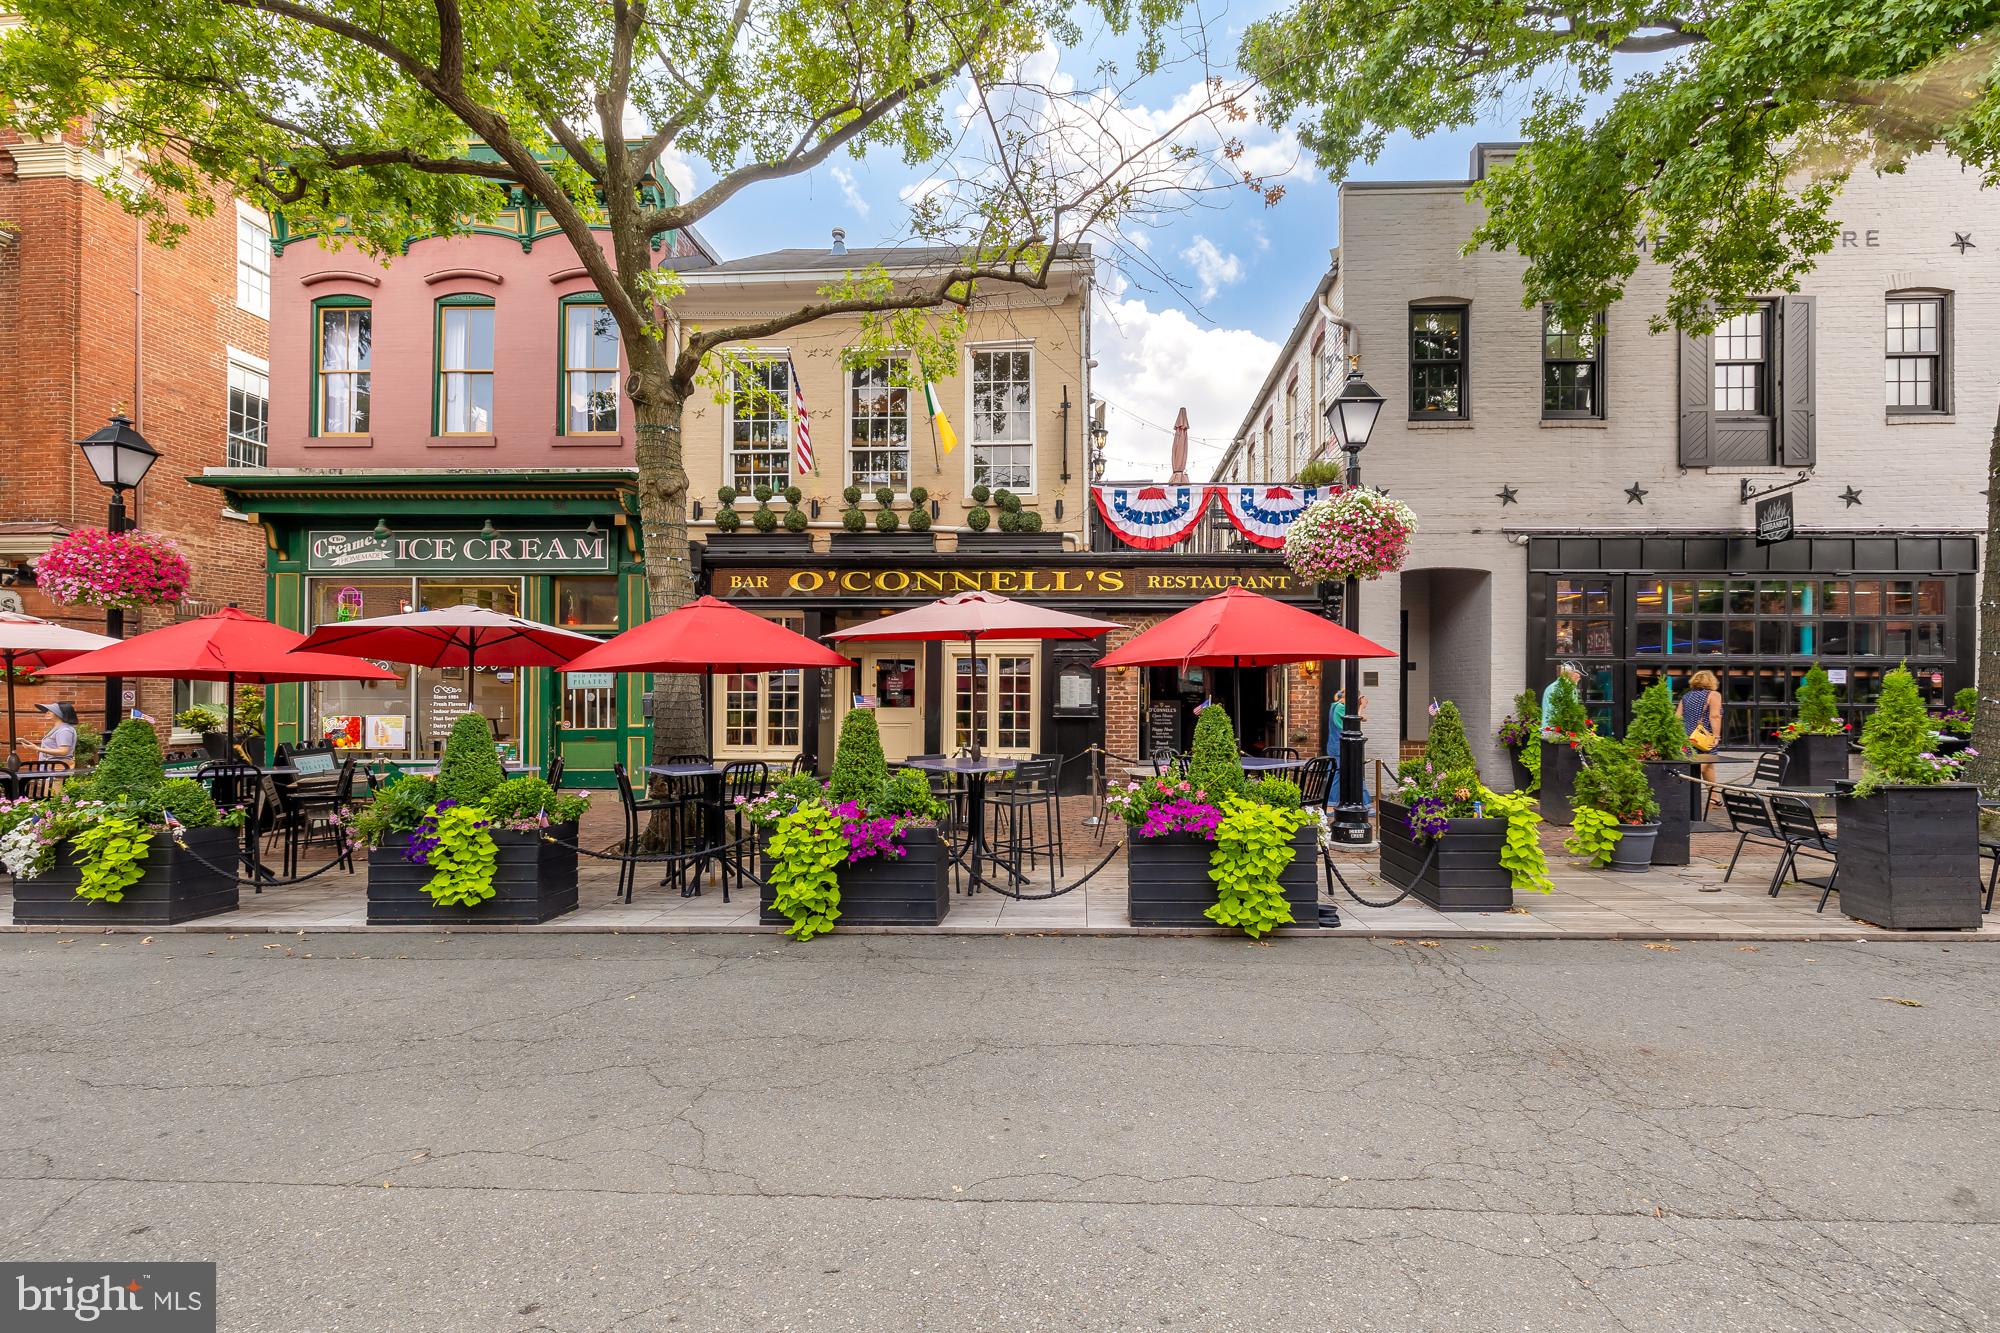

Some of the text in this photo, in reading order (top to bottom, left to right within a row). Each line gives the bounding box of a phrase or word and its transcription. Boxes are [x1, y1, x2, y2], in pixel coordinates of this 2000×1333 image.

[314, 536, 388, 558] Creame
[340, 552, 381, 563] HOMEMADE
[395, 537, 605, 562] ICE CREAM
[730, 570, 1291, 592] BAR O'CONNELL'S RESTAURANT
